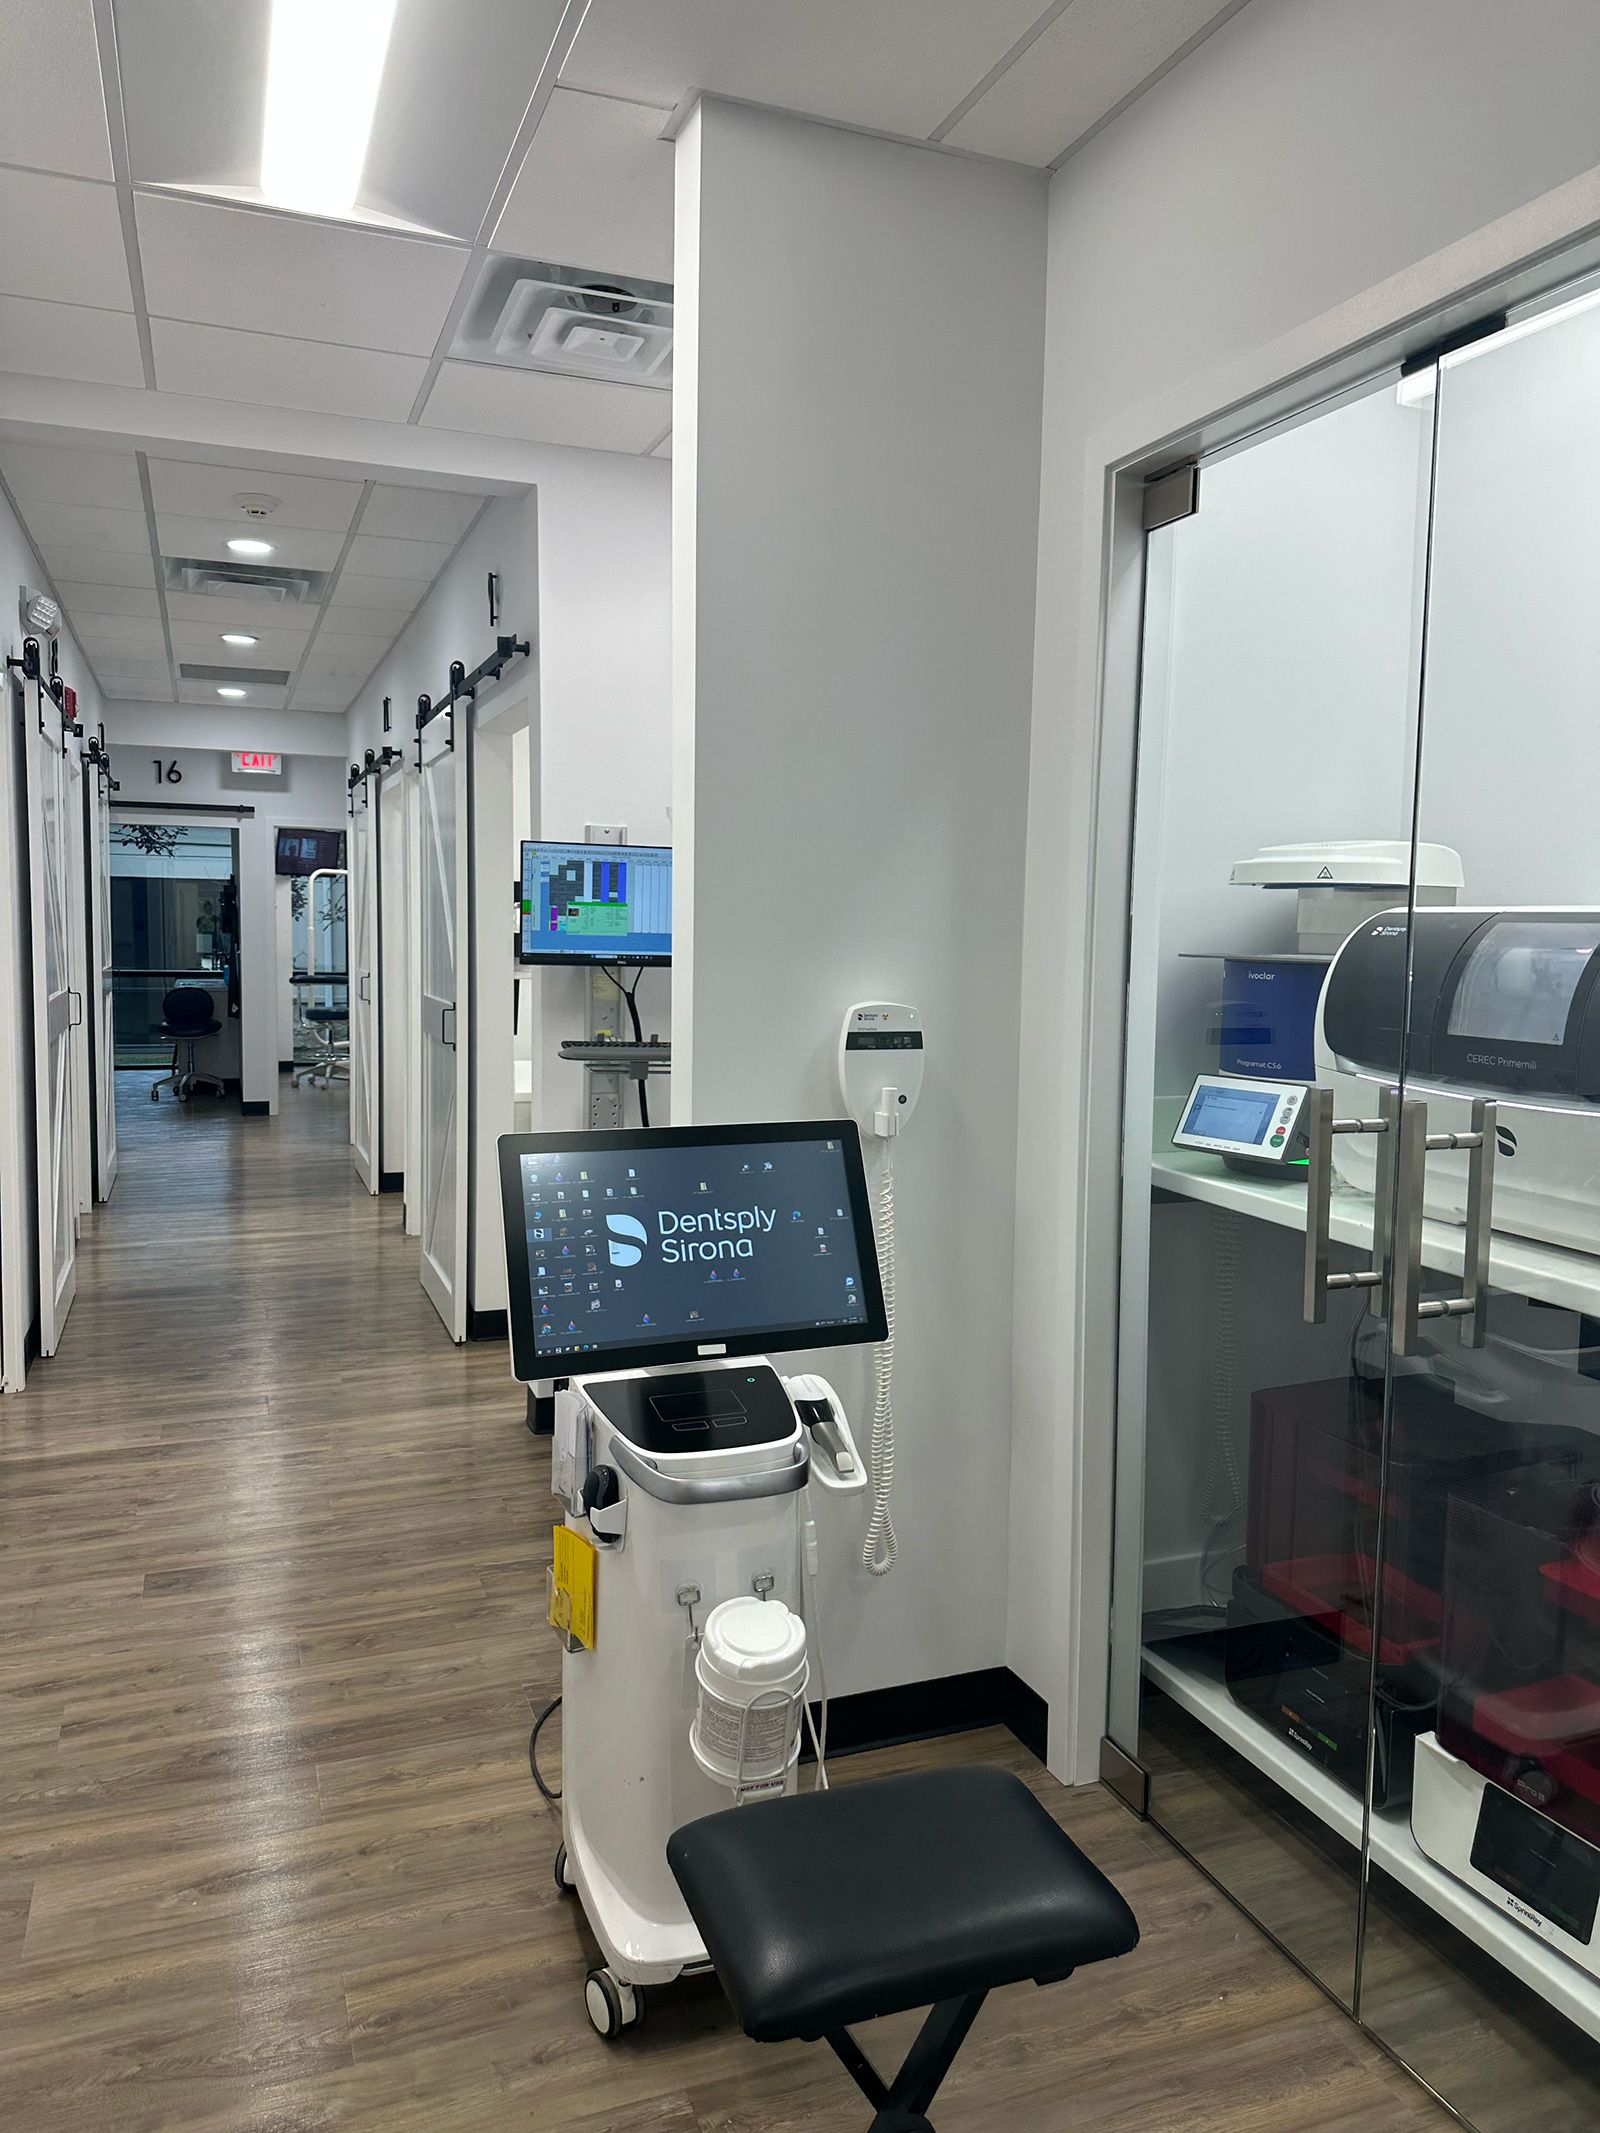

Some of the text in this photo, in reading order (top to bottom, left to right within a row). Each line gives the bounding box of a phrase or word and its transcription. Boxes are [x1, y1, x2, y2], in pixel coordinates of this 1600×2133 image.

[153, 760, 182, 784] 16
[1248, 970, 1275, 980] ivoclar
[1236, 1058, 1282, 1070] Programat CS6
[1466, 1053, 1537, 1070] CEREC Primemill
[658, 1205, 776, 1234] Dentsply
[661, 1238, 753, 1263] Sirona
[740, 1779, 784, 1793] NOT FOR USE
[1513, 1901, 1543, 1927] SprintRay
